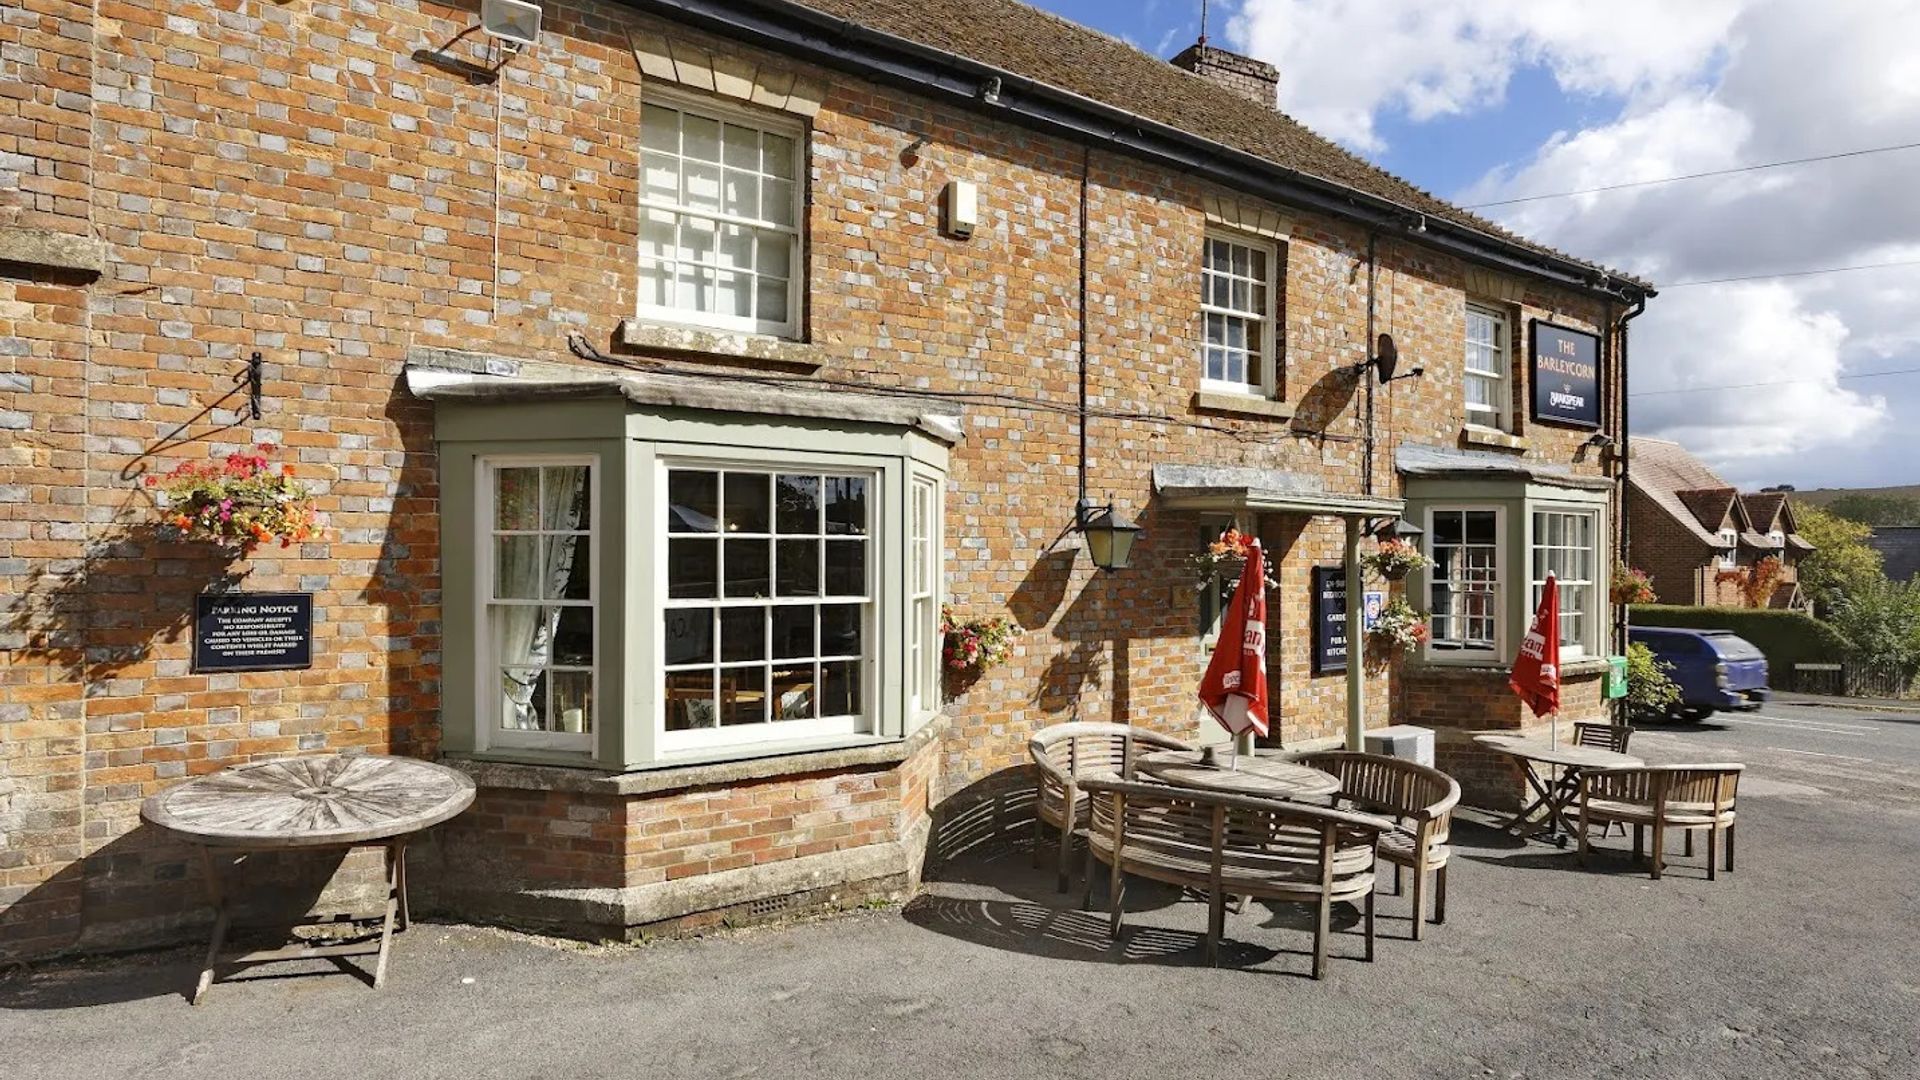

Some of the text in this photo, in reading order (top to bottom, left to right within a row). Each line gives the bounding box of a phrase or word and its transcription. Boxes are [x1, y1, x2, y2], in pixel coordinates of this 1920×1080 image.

[1557, 339, 1575, 356] THE
[1537, 354, 1595, 379] BARLEYCORN
[1323, 591, 1347, 599] BEDROO
[211, 605, 298, 615] PARKING NOTICE
[1327, 613, 1347, 622] GARDE
[1330, 637, 1342, 645] PUB
[1326, 648, 1347, 656] KITCHE
